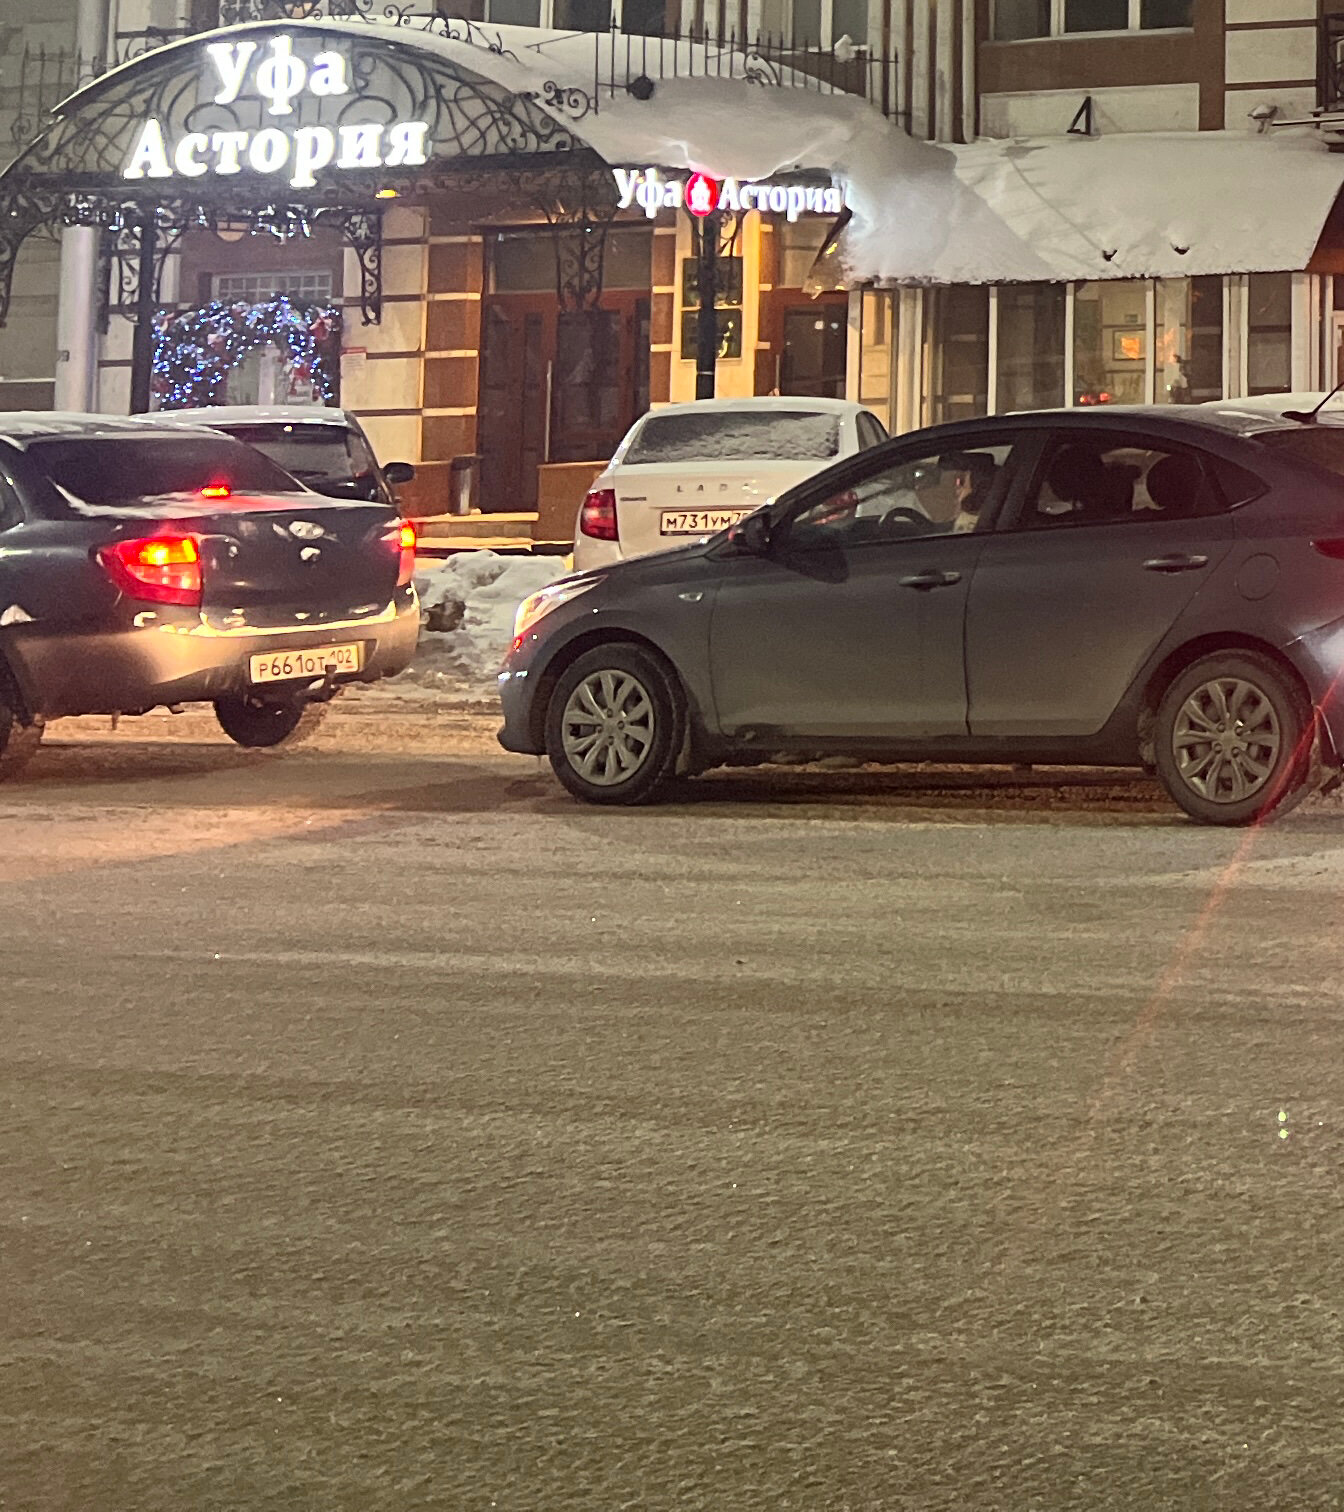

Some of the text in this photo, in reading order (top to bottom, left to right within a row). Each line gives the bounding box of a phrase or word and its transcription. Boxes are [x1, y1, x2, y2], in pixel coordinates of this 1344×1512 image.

[206, 34, 349, 115] Уфа
[124, 118, 429, 188] Астория
[612, 168, 842, 222] Уфа Астория
